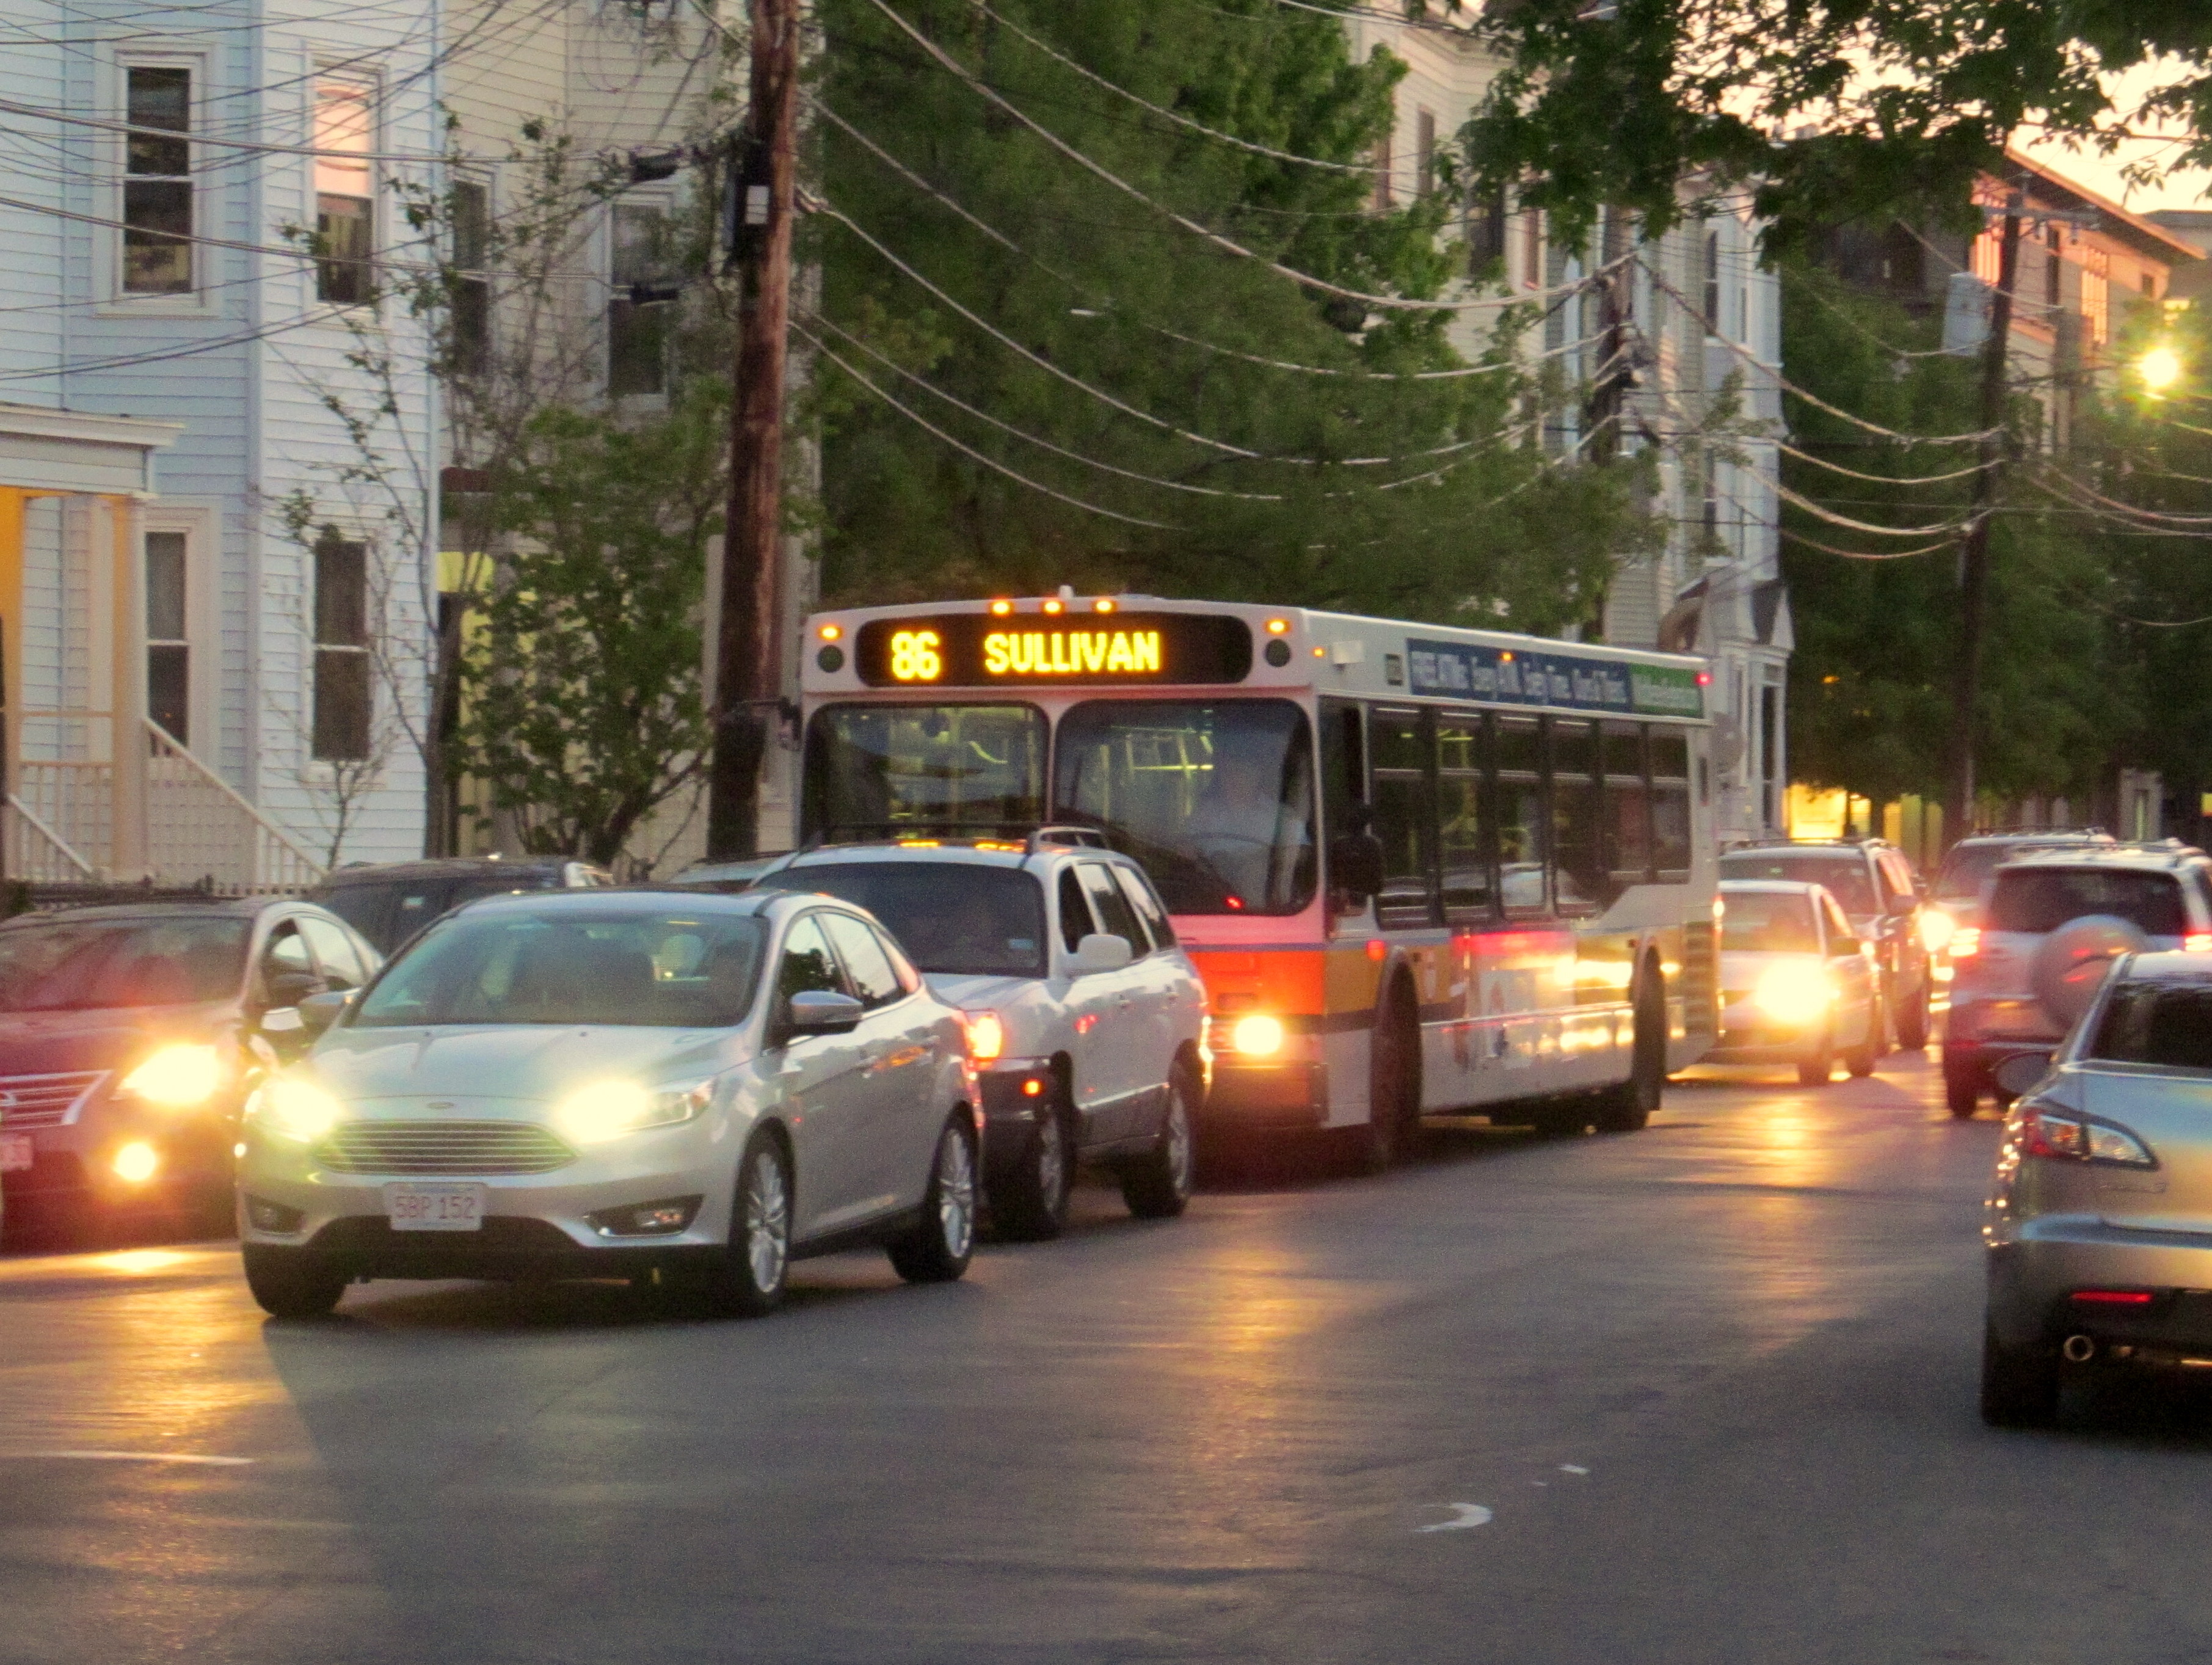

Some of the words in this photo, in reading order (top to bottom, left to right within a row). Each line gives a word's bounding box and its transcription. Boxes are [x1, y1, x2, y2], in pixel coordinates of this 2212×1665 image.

[891, 632, 940, 680] 86
[984, 632, 1160, 674] SULLIVAN
[438, 1195, 476, 1220] 152
